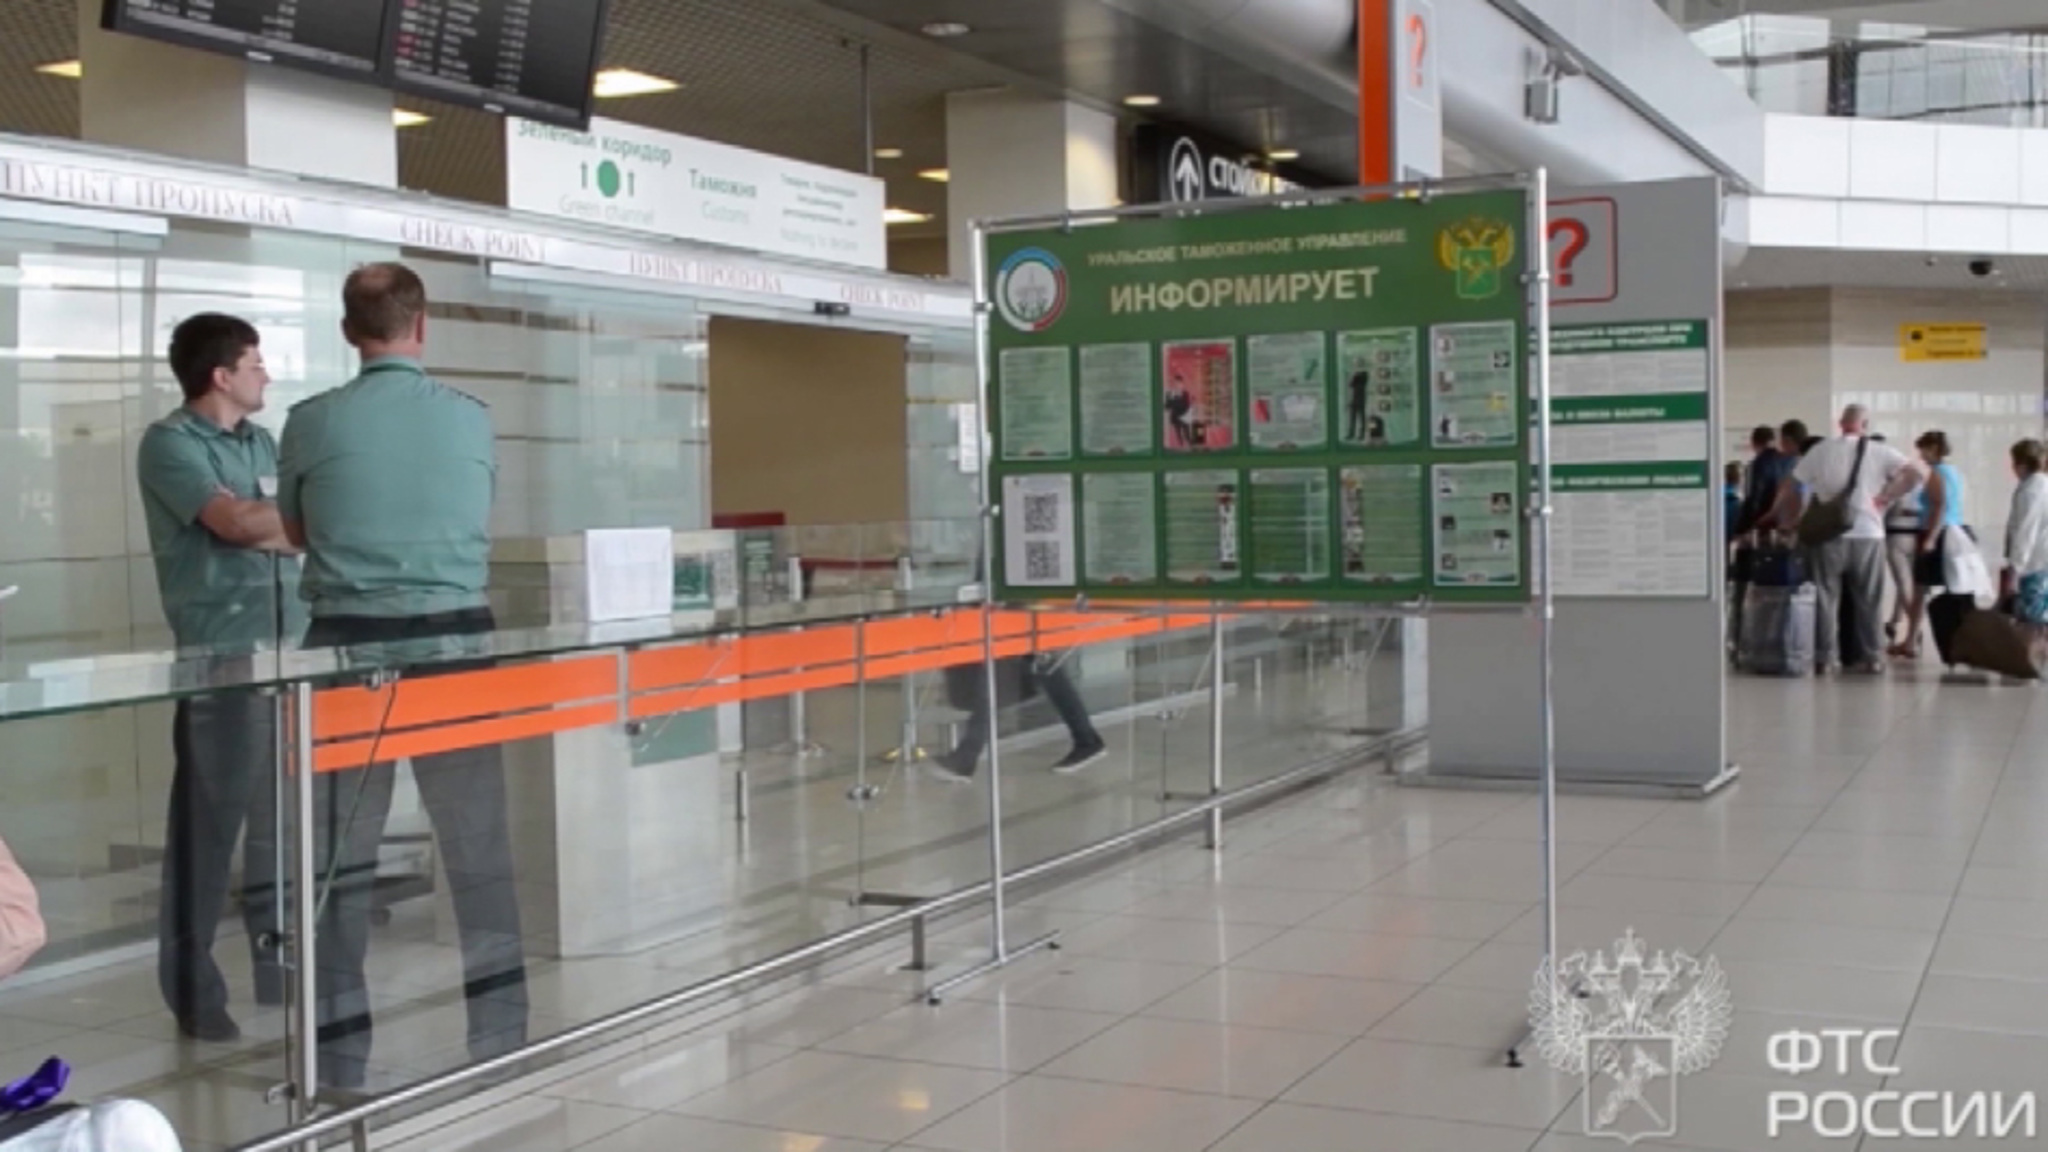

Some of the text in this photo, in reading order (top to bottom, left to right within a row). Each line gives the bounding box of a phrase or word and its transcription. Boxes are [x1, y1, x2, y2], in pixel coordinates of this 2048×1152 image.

[602, 134, 672, 168] коридор
[5, 161, 294, 226] ПУНКТ ПРОПУСКА
[689, 168, 757, 199] Таможня
[559, 194, 655, 226] Green channel
[400, 218, 548, 262] CHECK POINT
[1087, 228, 1407, 266] УРАЛЬСКОЕ ТАМОЖЕННОЕ УПРАВЛЕНИЕ
[1110, 266, 1380, 314] ИНФОРМИРУЕТ
